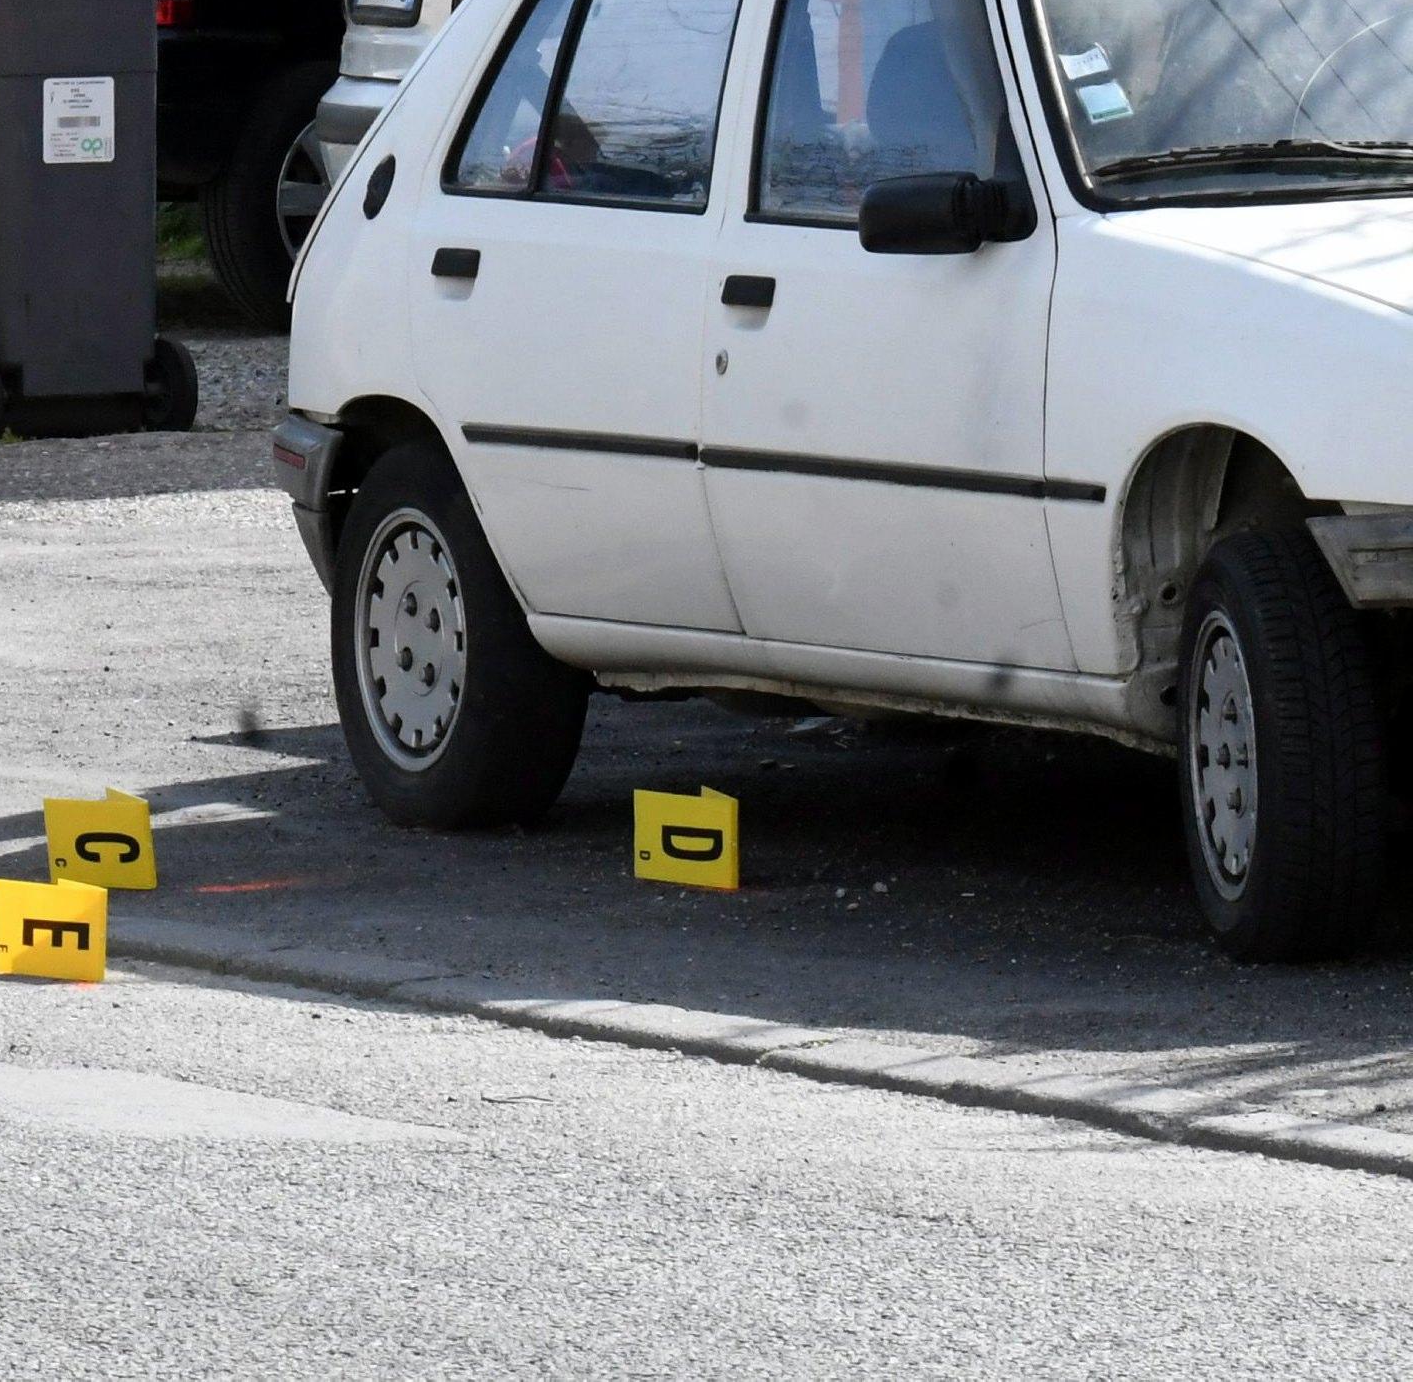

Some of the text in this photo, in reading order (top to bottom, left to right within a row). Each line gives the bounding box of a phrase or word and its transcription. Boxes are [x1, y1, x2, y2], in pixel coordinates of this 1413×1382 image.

[75, 832, 140, 863] C
[662, 825, 723, 861] D
[55, 858, 67, 868] C
[23, 918, 90, 950] E
